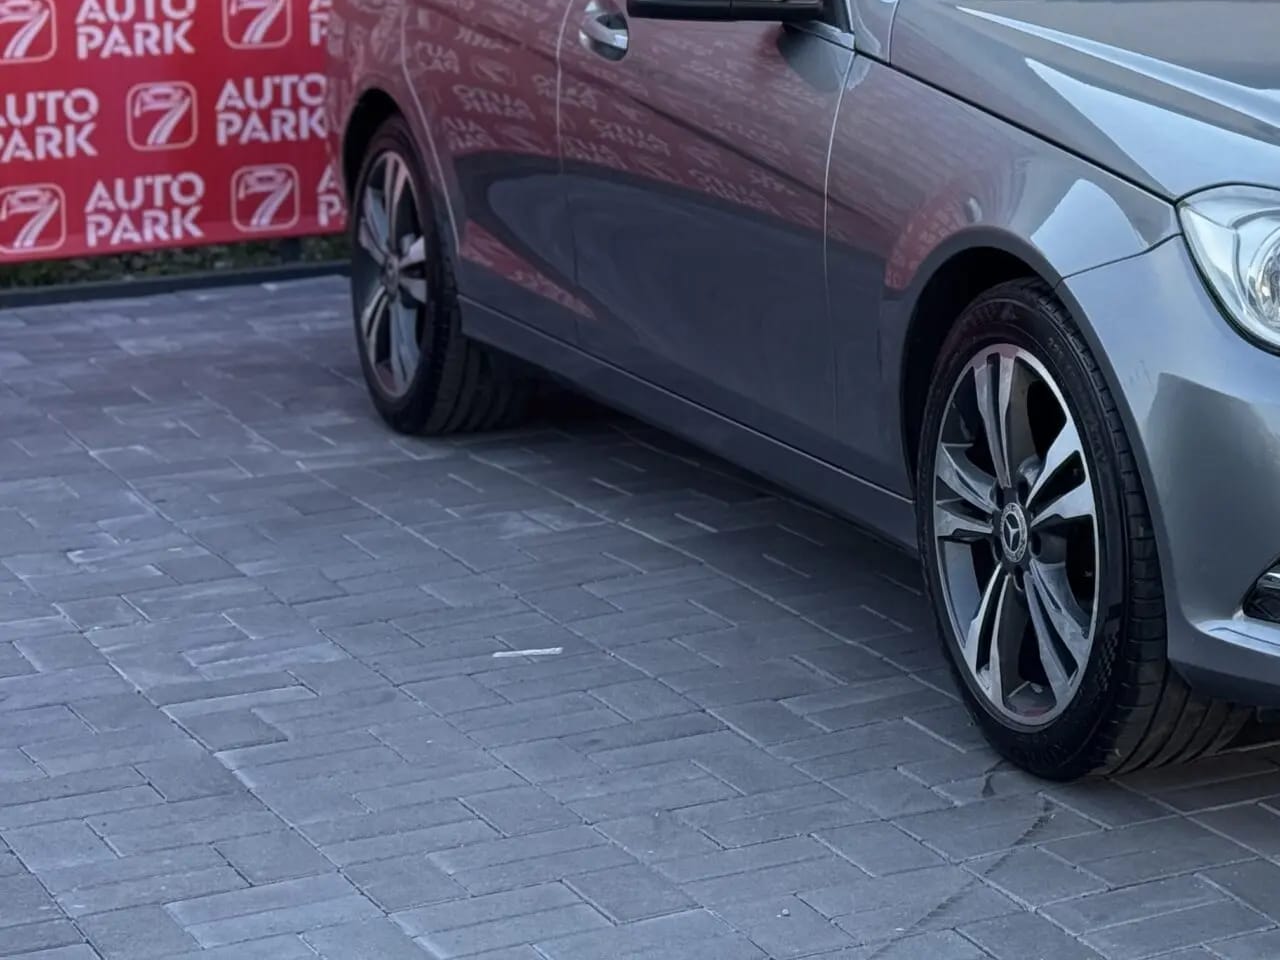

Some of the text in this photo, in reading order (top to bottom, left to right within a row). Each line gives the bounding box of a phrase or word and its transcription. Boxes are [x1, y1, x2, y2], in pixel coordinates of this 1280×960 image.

[76, 20, 195, 58] PARK
[215, 72, 327, 111] AUTO
[85, 173, 205, 213] AUTO
[86, 206, 206, 247] PARK
